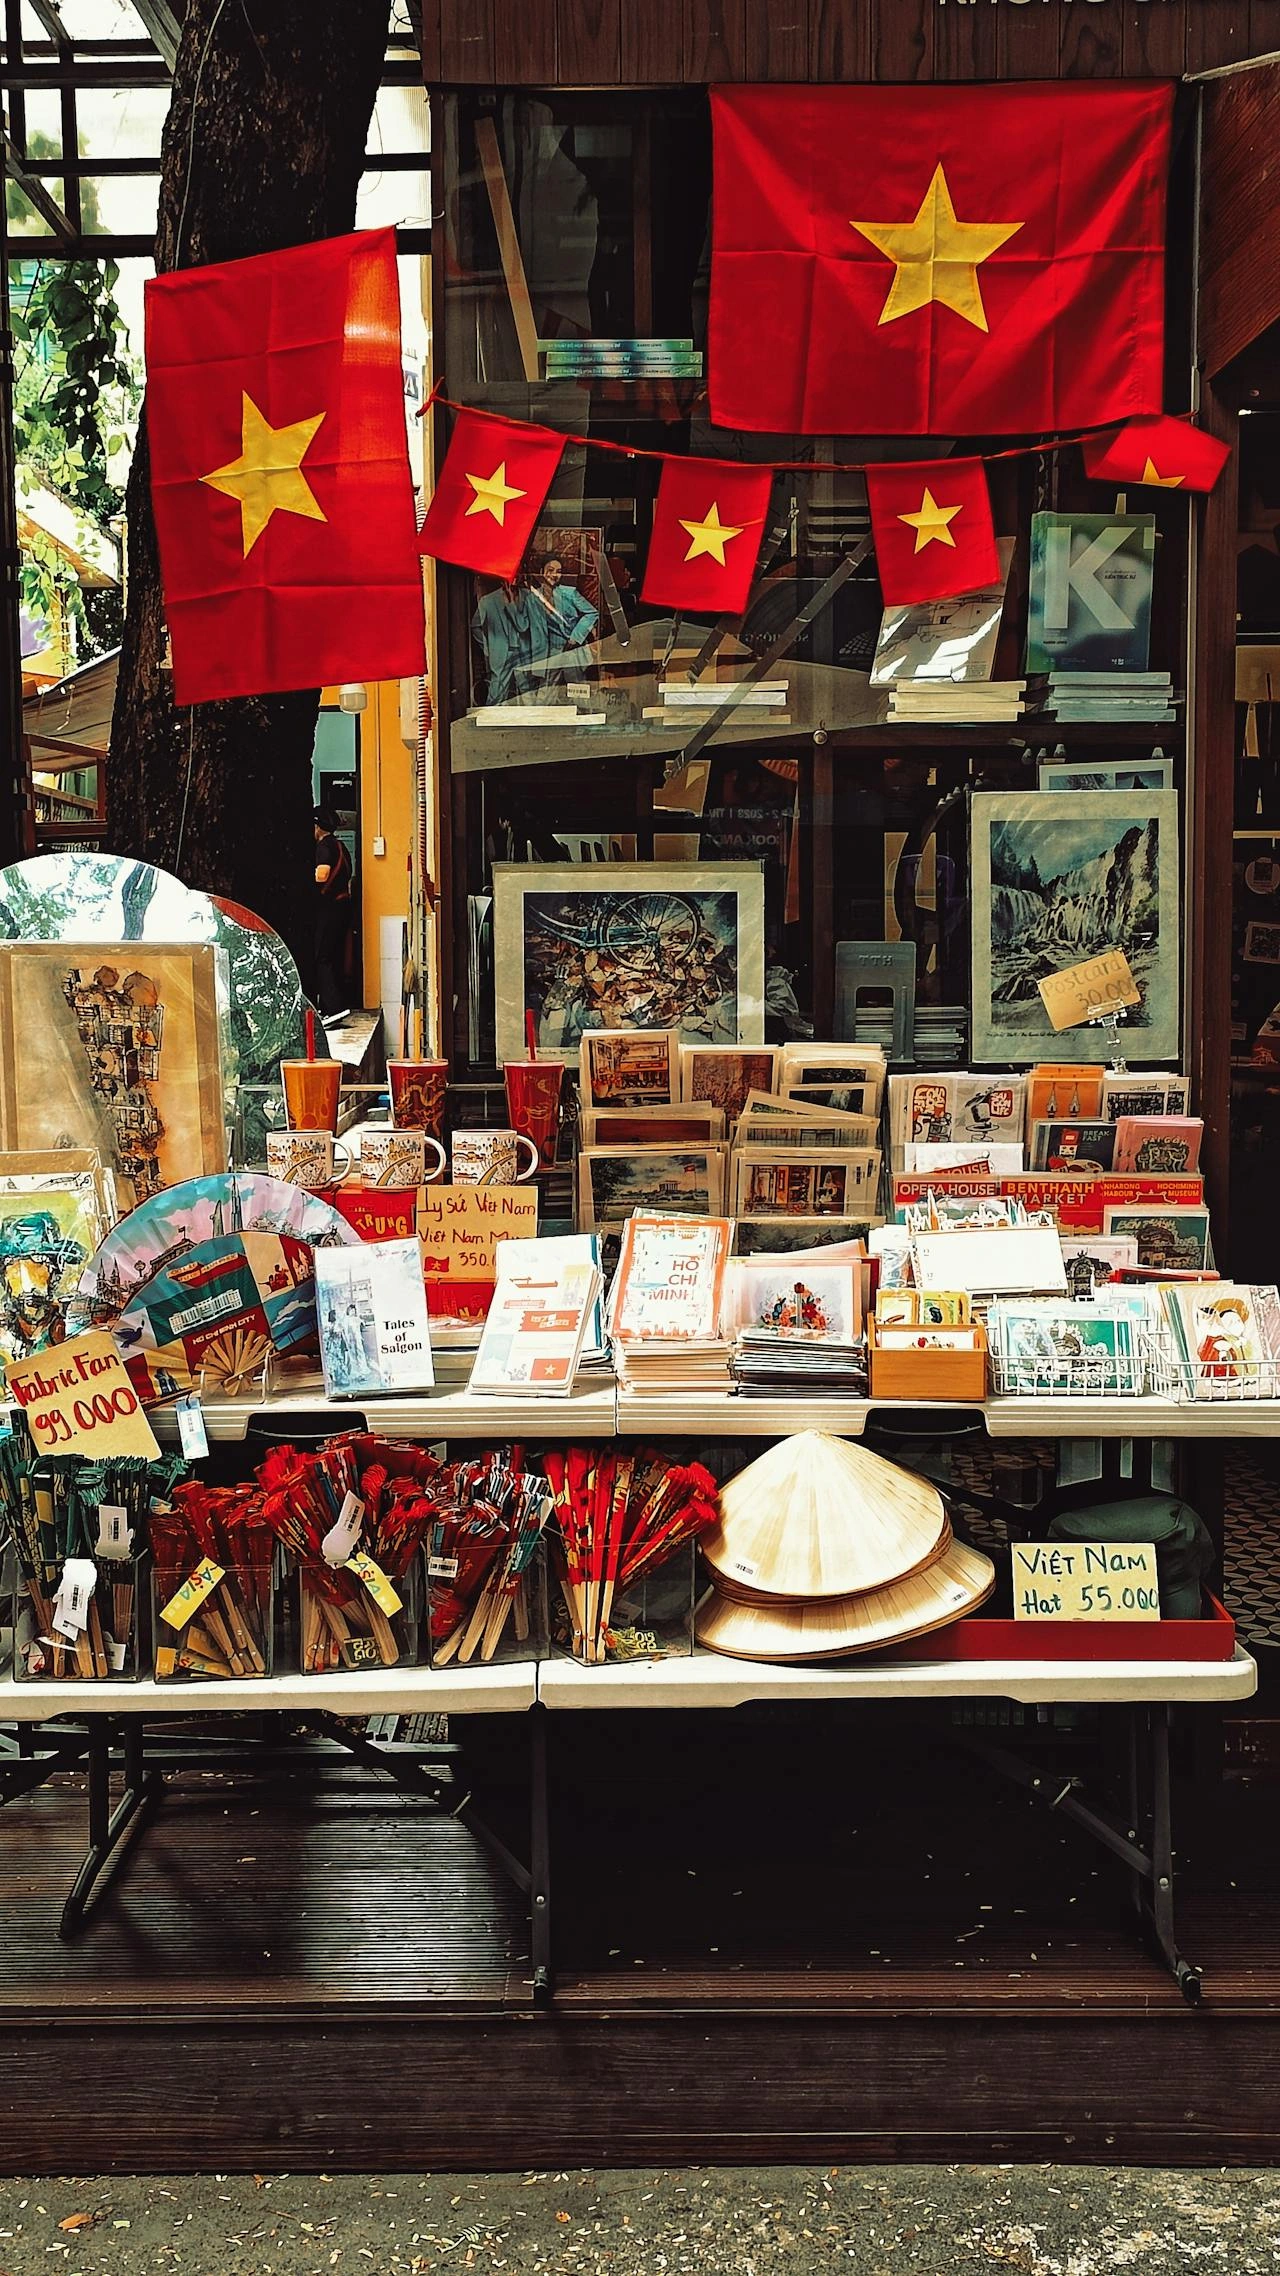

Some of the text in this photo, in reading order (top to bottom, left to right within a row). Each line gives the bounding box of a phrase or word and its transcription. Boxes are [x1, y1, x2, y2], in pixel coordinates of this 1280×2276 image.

[1044, 527, 1137, 629] K
[900, 1183, 995, 1196] OPERA HOUSE
[1007, 1183, 1095, 1194] BENTHANH
[502, 1198, 536, 1216] Nam
[1015, 1193, 1087, 1205] MARKET
[355, 1213, 408, 1235] TRUNG
[452, 1228, 484, 1244] Nam
[458, 1251, 497, 1267] 350.
[383, 1320, 415, 1330] Tales
[394, 1332, 408, 1342] of
[381, 1342, 422, 1354] Saigon
[10, 1351, 120, 1408] Fabric Fan
[35, 1386, 138, 1445] 99.000
[1021, 1583, 1159, 1615] Hat 55.000
